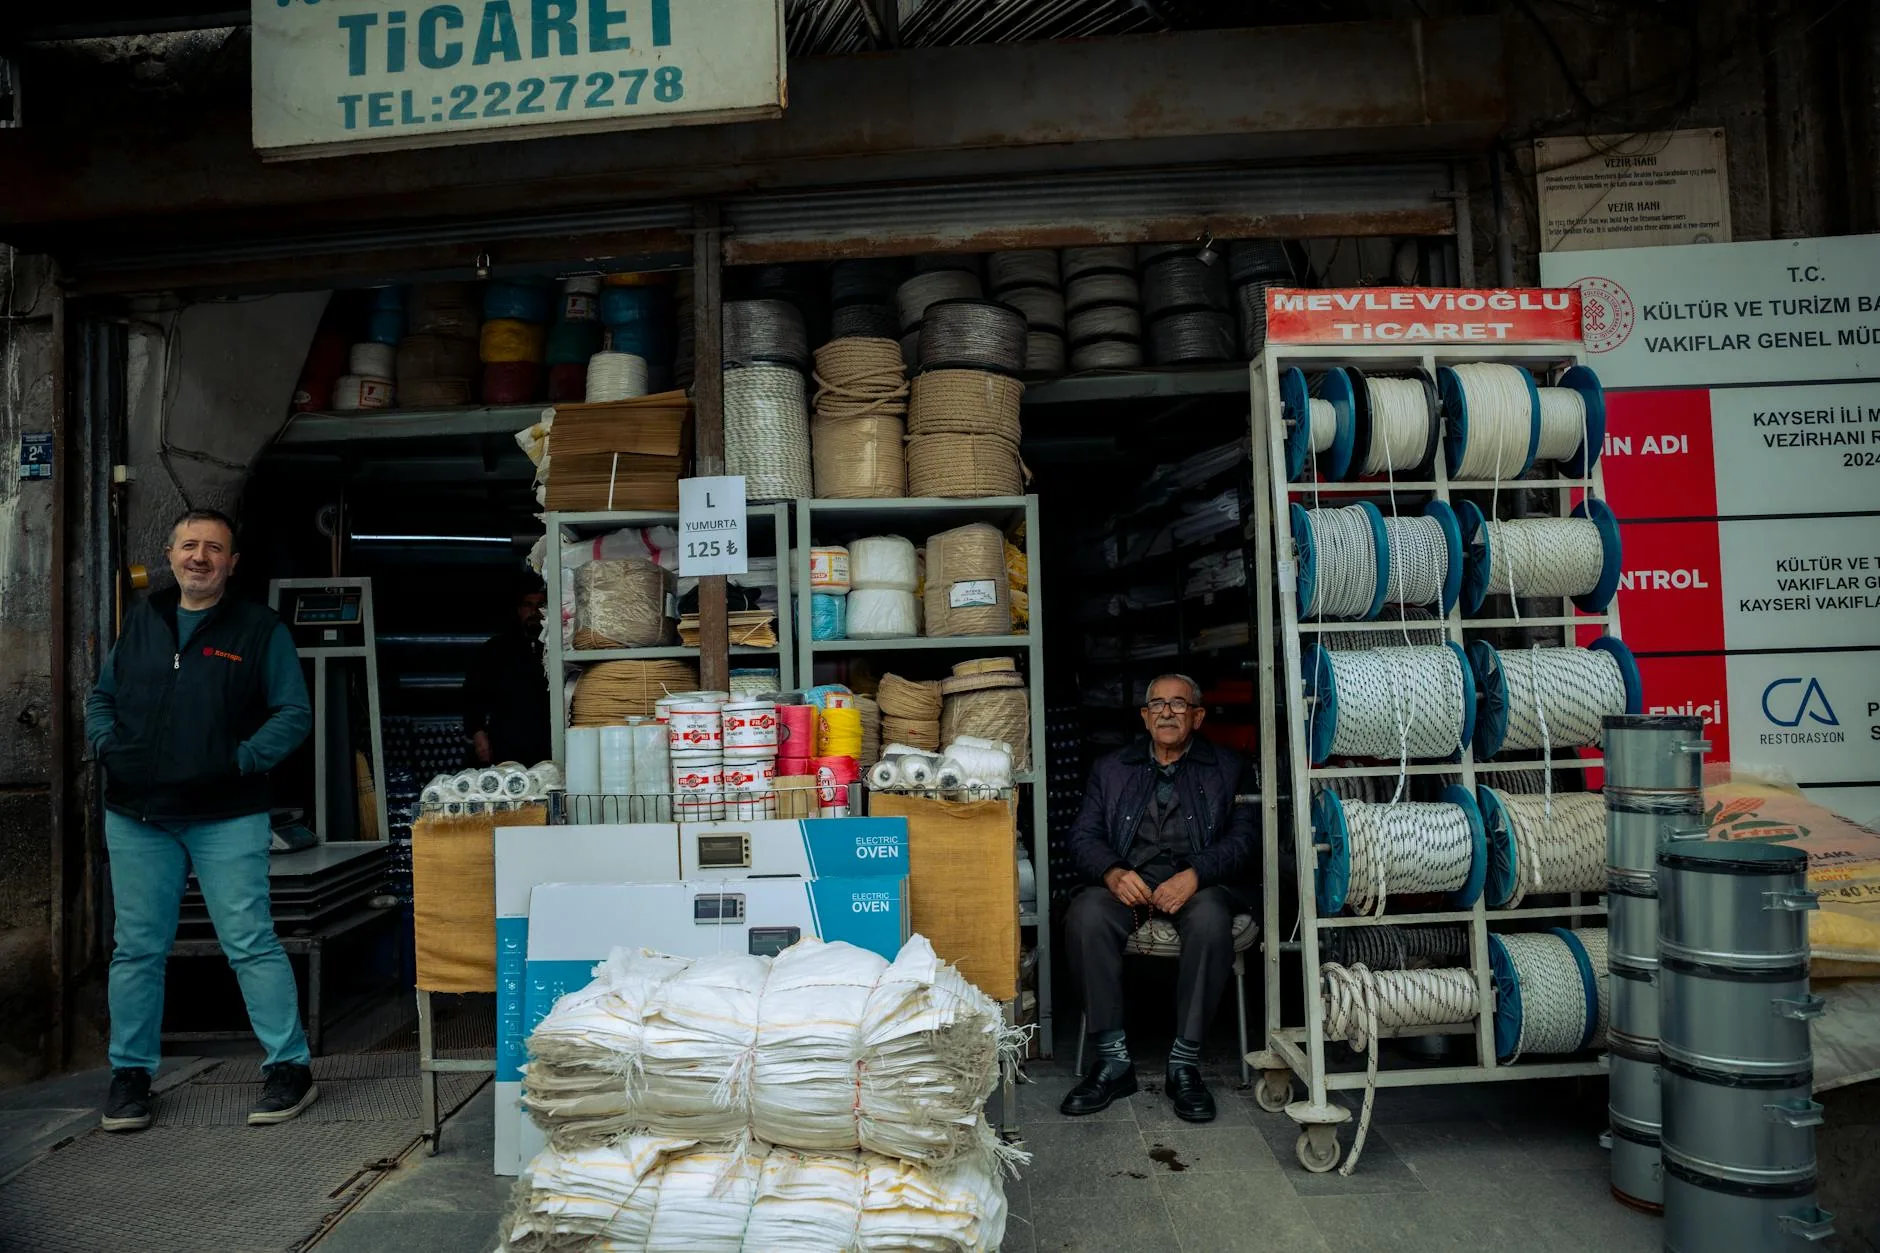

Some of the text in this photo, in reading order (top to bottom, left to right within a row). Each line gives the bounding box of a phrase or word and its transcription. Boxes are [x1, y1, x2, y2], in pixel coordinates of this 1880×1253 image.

[337, 65, 684, 130] TEL:2227278
[1787, 266, 1825, 283] T.C.
[1643, 299, 1729, 321] KÜLTÜR
[1734, 300, 1763, 317] VE
[1769, 295, 1850, 317] TURİZM
[1644, 334, 1751, 353] VAKIFLAR
[1758, 331, 1832, 349] GENEL
[1753, 406, 1835, 426] KAYSERİ
[1841, 405, 1862, 423] İLİ
[1600, 432, 1689, 457] İN ADI
[1763, 430, 1865, 448] VEZİRHANI
[706, 492, 716, 508] L
[685, 519, 737, 531] YUMURTA
[687, 541, 721, 558] 125
[1776, 556, 1843, 573] KÜLTÜR
[1847, 557, 1869, 571] VE
[1777, 575, 1880, 593] VAKIFLAR G
[1740, 594, 1811, 612] KAYSERİ
[1760, 731, 1845, 745] RESTORASYON
[855, 836, 898, 845] ELECTRIC
[856, 845, 899, 859] OVEN
[851, 892, 890, 901] ELECTRIC
[851, 900, 890, 913] OVEN
